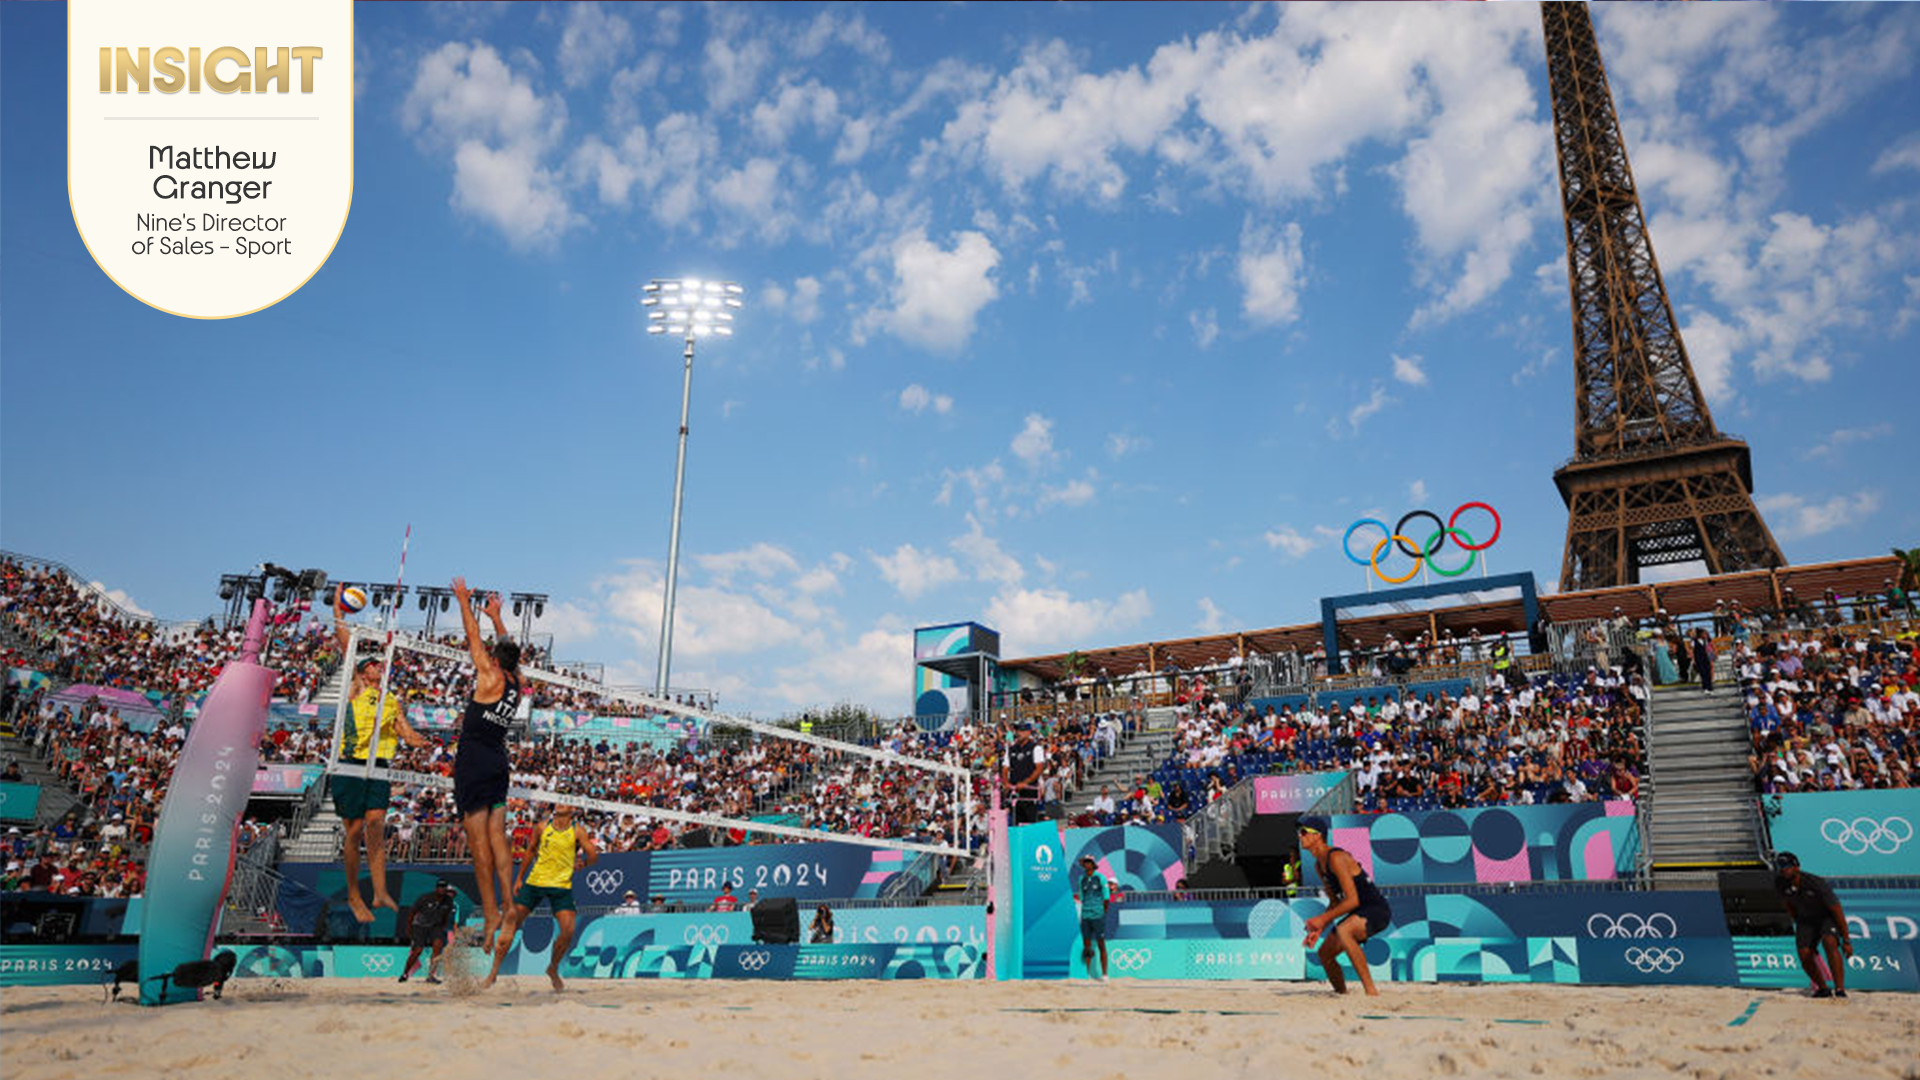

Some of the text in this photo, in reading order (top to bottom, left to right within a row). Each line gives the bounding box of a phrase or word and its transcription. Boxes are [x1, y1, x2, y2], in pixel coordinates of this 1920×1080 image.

[507, 689, 517, 703] 2
[188, 746, 234, 881] PARIS 2024
[668, 862, 828, 890] PARIS 2024
[1, 958, 113, 972] PARIS 2024
[801, 954, 877, 966] PARIS 2024
[1195, 952, 1244, 966] PARIS
